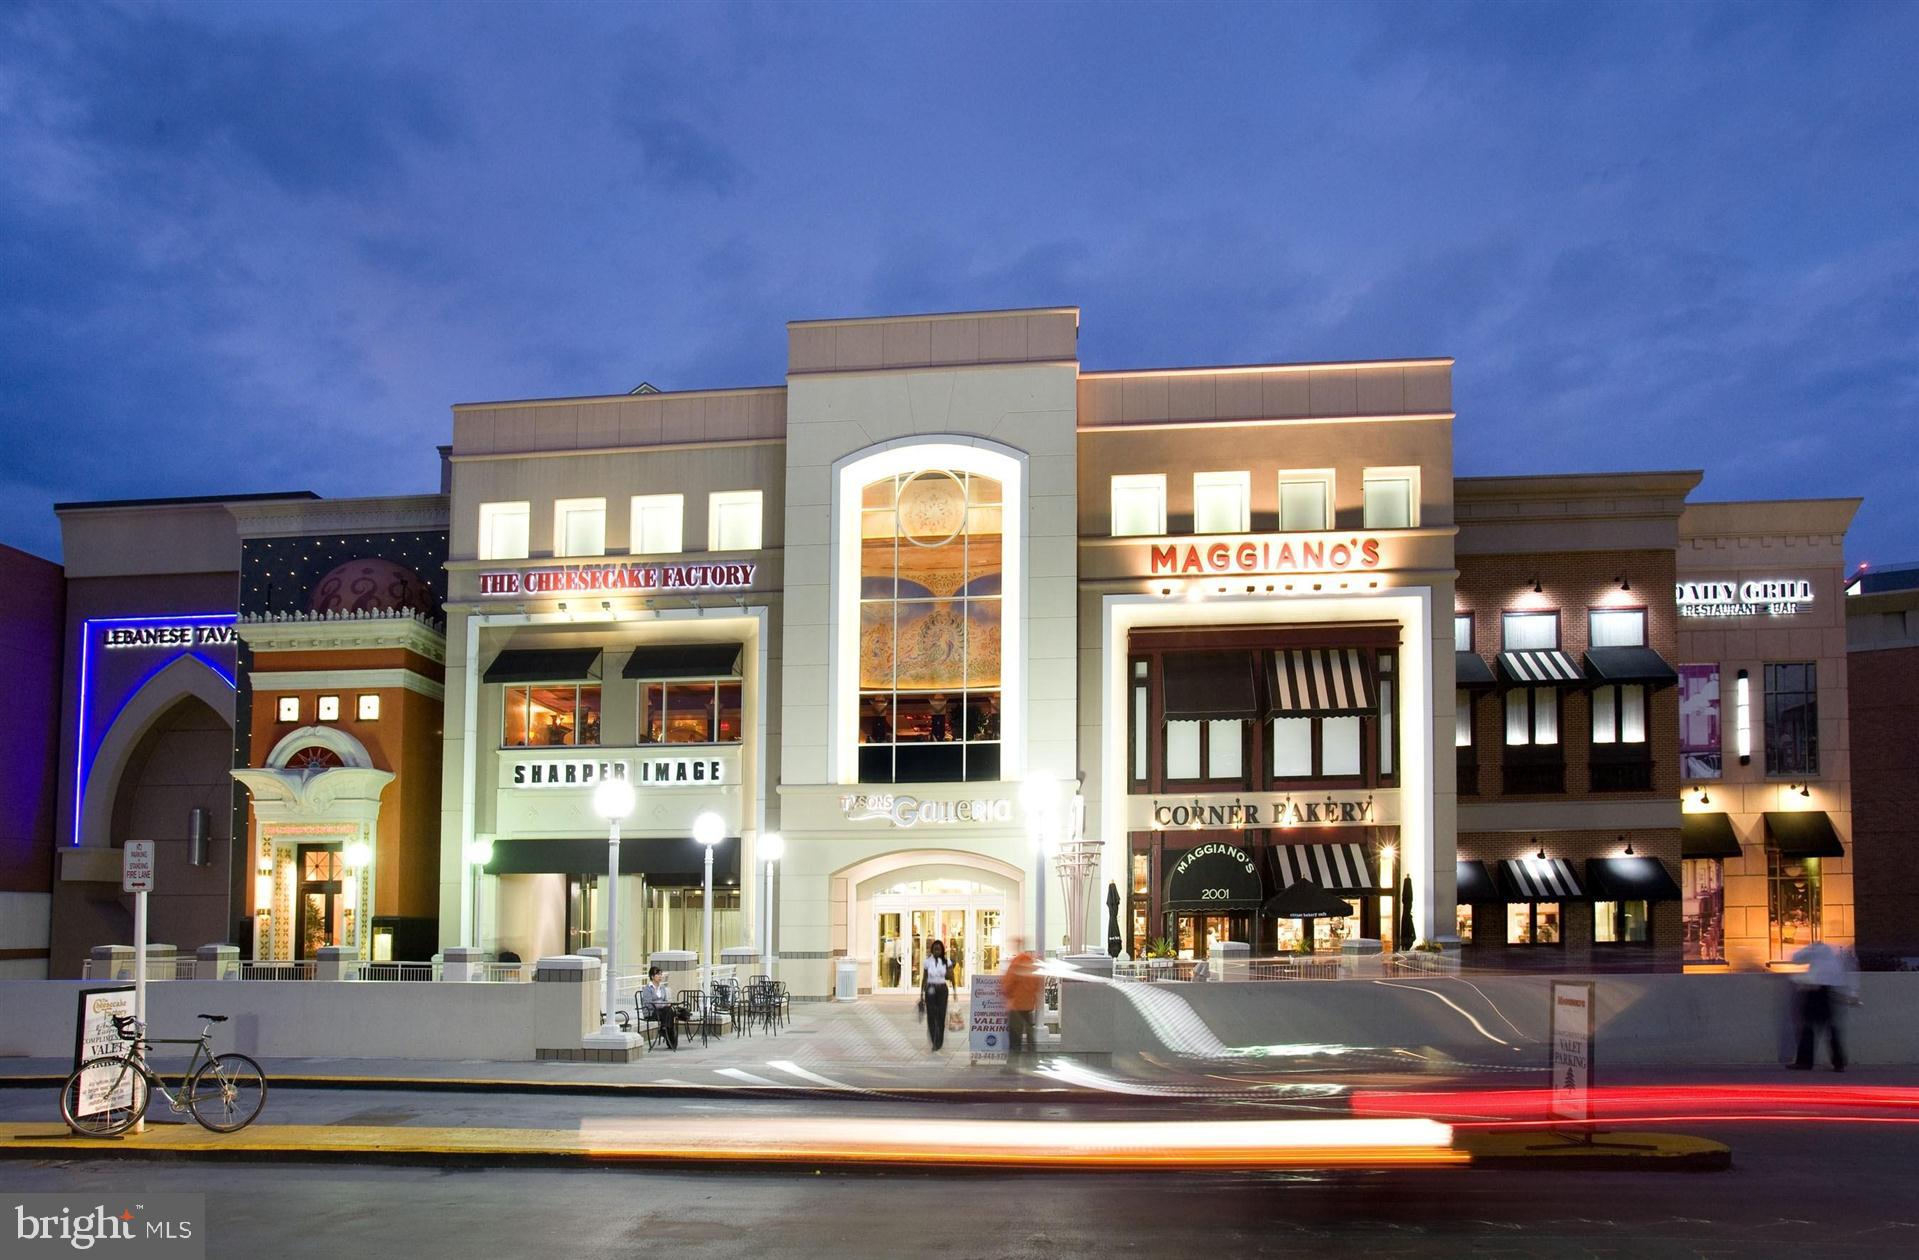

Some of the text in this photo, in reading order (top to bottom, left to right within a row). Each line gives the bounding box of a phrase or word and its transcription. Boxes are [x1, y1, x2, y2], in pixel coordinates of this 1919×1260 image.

[1151, 538, 1380, 574] MAGGIANO'S
[479, 564, 755, 594] THE CHEESECAKE FACTORY
[1741, 582, 1814, 601] GRILL
[1685, 602, 1798, 615] RESTAURANT BAR
[103, 627, 191, 645] LEBANESE
[514, 761, 720, 784] SHARPER IMAGE
[1156, 801, 1372, 825] CORNER BAKERY
[1176, 843, 1255, 875] MAGGIANO'S
[1201, 888, 1229, 900] 2001
[91, 1042, 124, 1055] VALET
